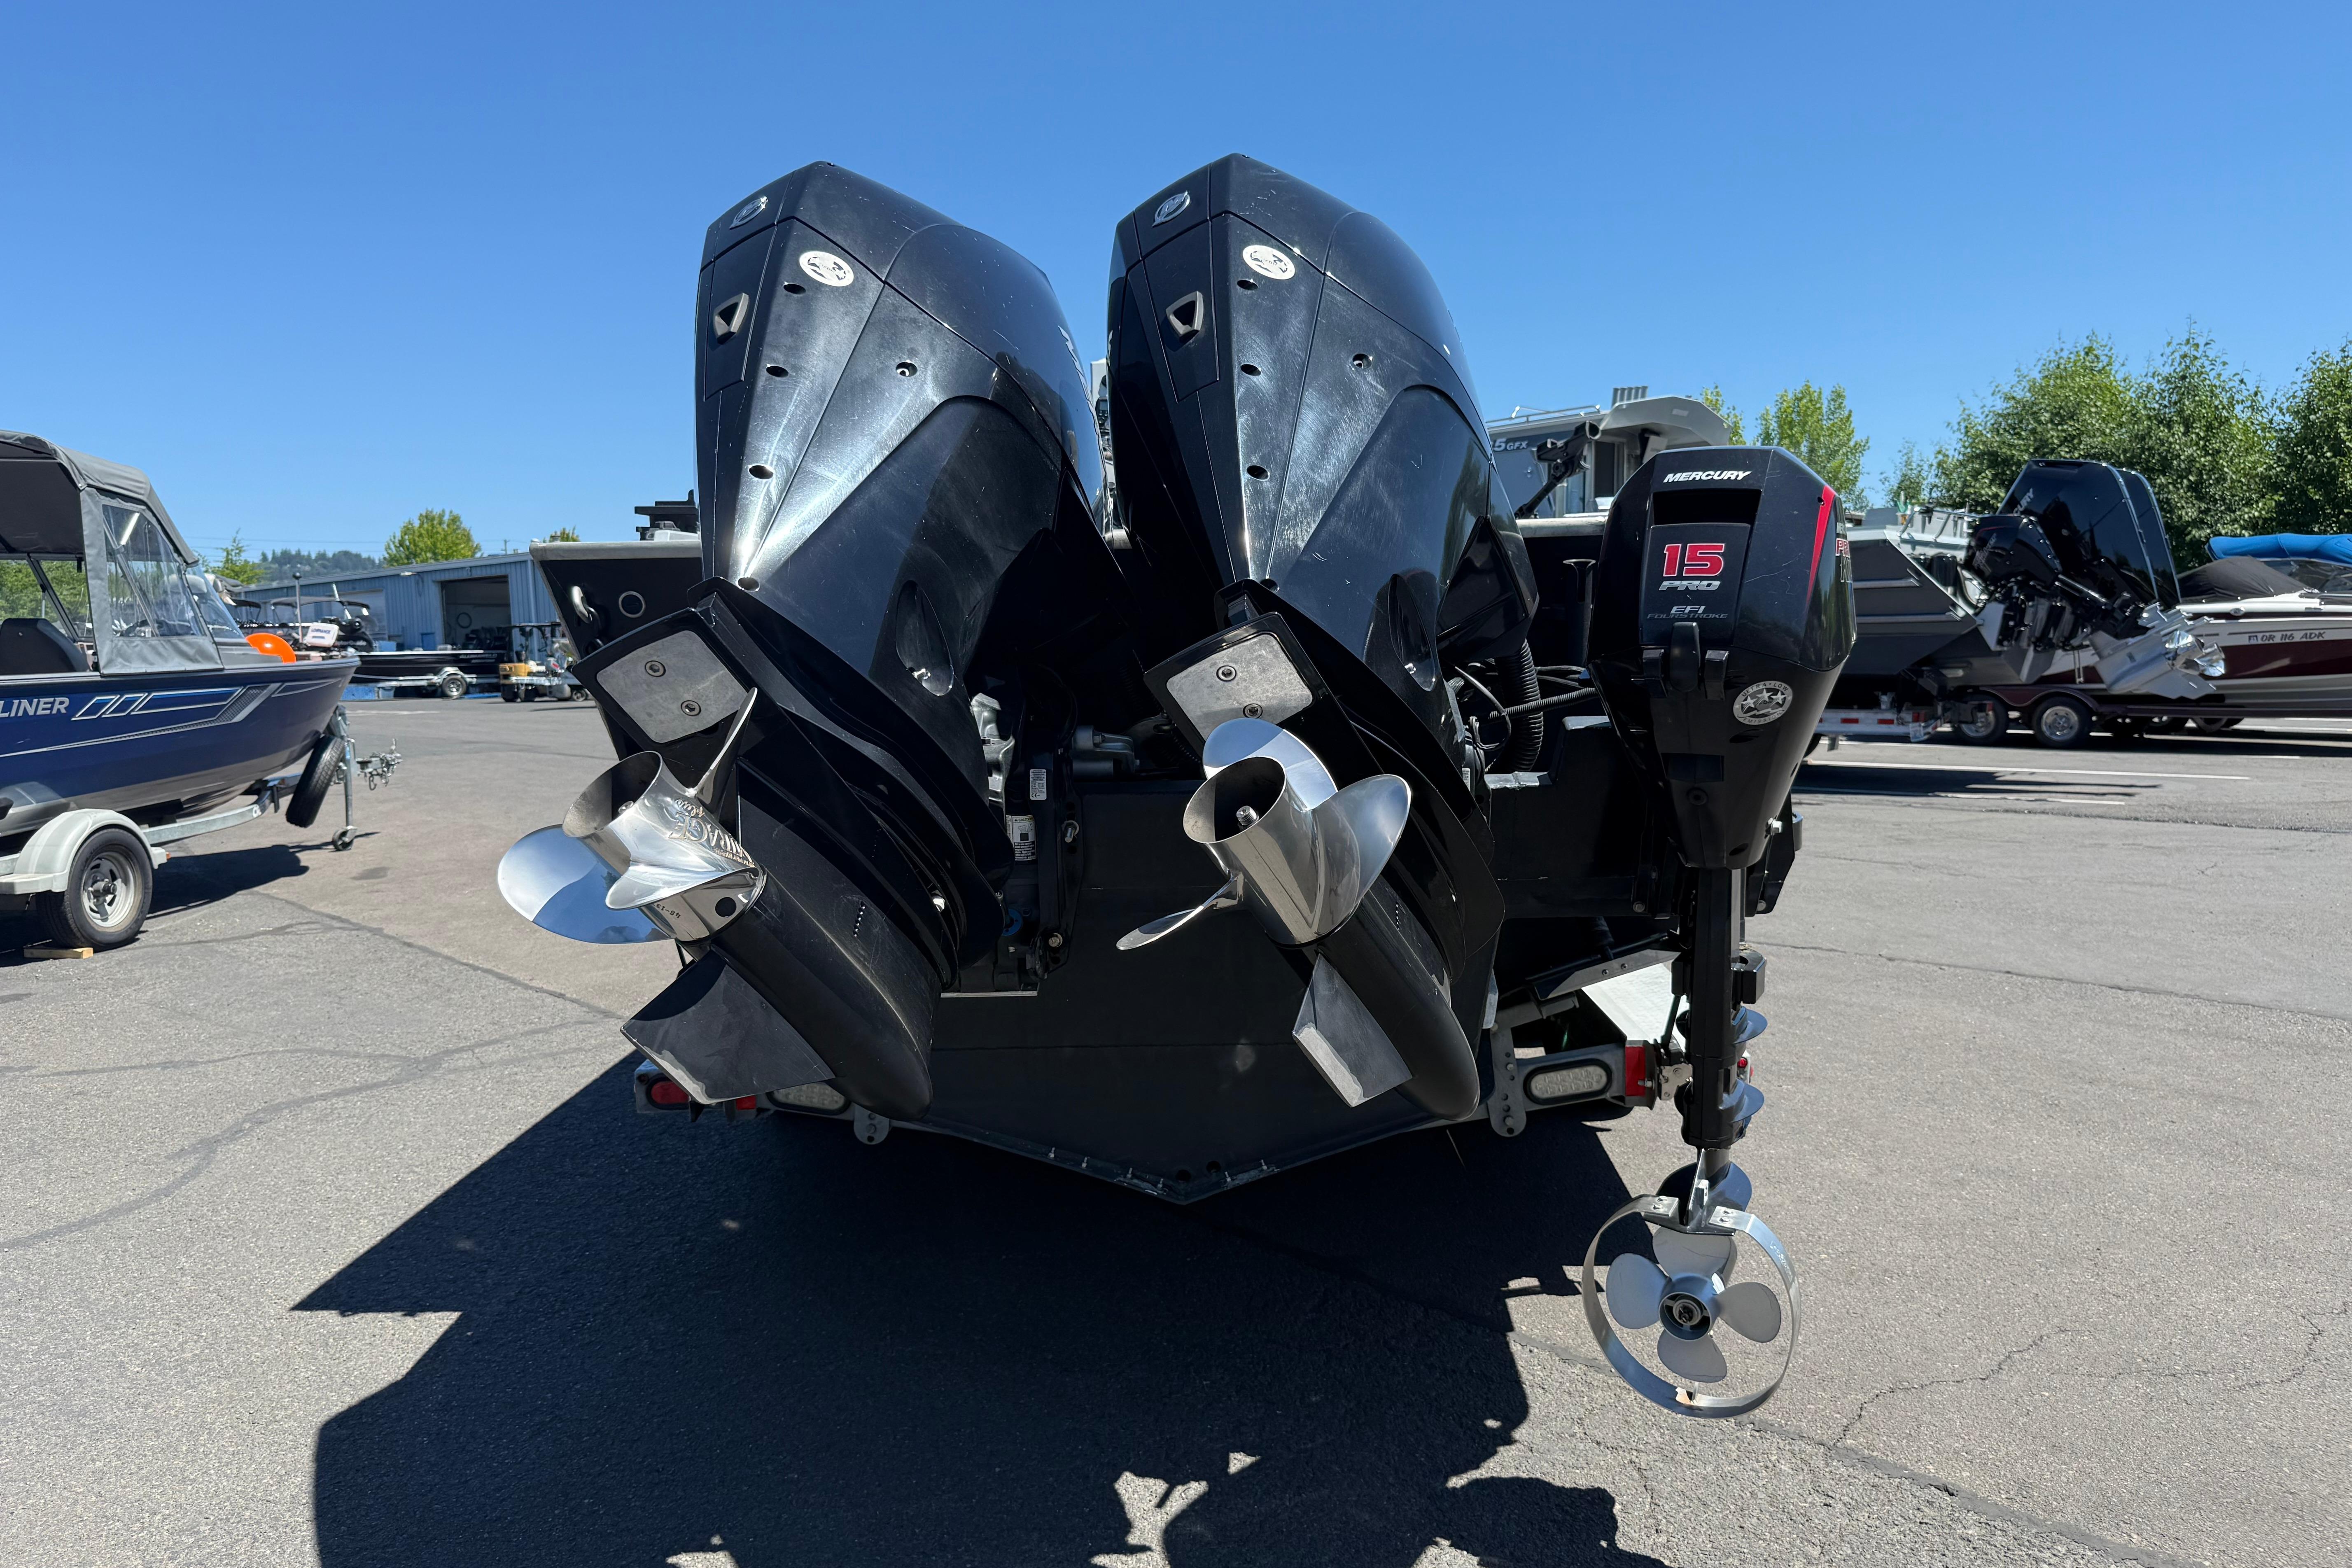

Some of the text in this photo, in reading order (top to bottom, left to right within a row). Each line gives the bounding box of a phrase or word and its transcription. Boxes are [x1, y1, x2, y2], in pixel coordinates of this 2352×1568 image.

[1507, 440, 1528, 450] GFX
[1663, 471, 1752, 483] MERCURY
[1663, 543, 1726, 577] 15
[1659, 580, 1720, 590] PRO
[1670, 606, 1706, 614] EFI
[2280, 633, 2294, 641] 116
[2300, 631, 2326, 640] ADK
[1742, 683, 1789, 697] ULTRA LOW
